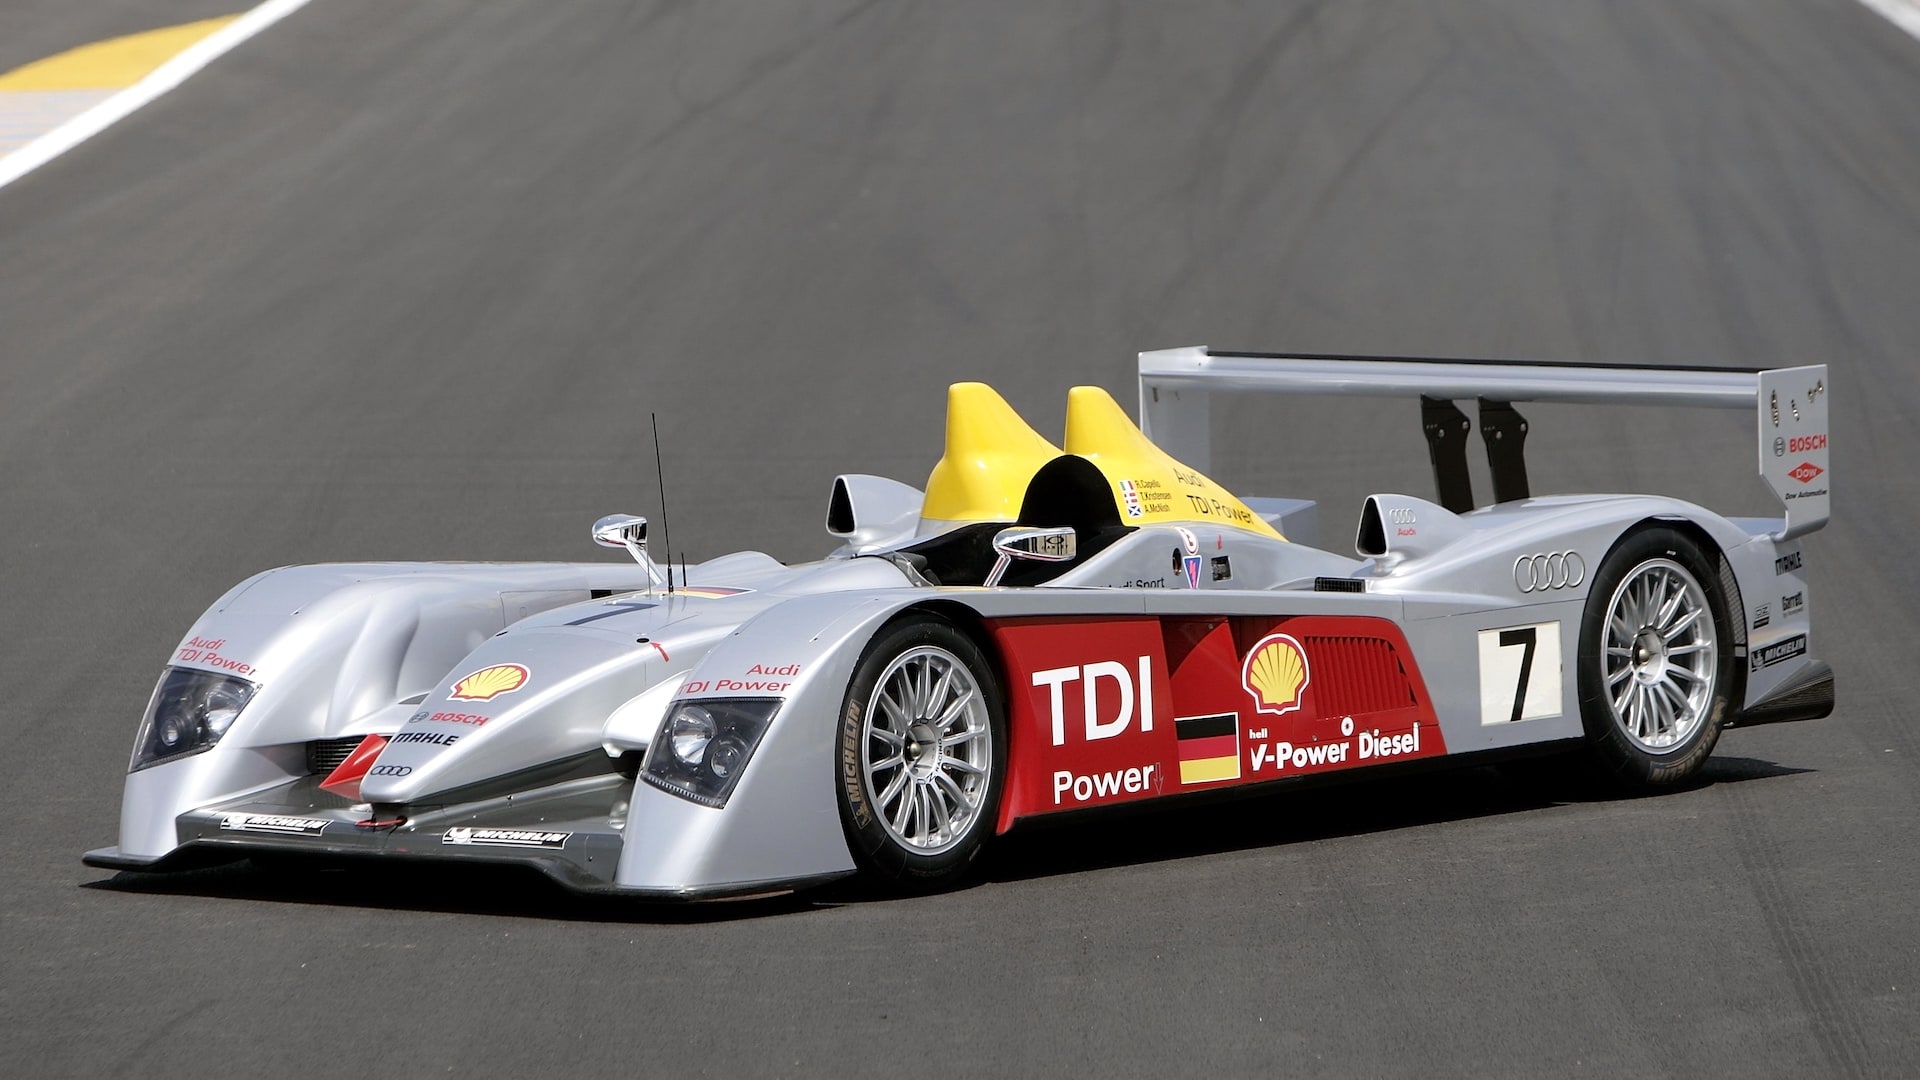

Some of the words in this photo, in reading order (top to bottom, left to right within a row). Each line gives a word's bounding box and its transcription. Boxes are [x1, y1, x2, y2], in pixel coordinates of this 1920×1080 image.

[1789, 434, 1826, 453] BOSCH
[1173, 468, 1206, 488] Audi
[1186, 495, 1214, 515] TDI
[1213, 499, 1254, 525] Power
[185, 636, 226, 650] Audi
[1765, 637, 1806, 662] MICHELIN
[176, 649, 203, 662] TDI
[201, 652, 256, 676] Power
[746, 664, 800, 676] Audi
[1499, 627, 1537, 722] 7
[715, 680, 791, 692] Power
[1032, 655, 1153, 746] TDI
[429, 712, 489, 726] BOSCH
[391, 732, 459, 746] MAHLE
[1250, 741, 1350, 772] V-Power
[1358, 722, 1420, 759] Diesel
[845, 702, 862, 802] MICHELIN
[1053, 764, 1155, 805] Power
[247, 816, 328, 829] MICHELIN
[473, 830, 566, 842] MICHELIN
